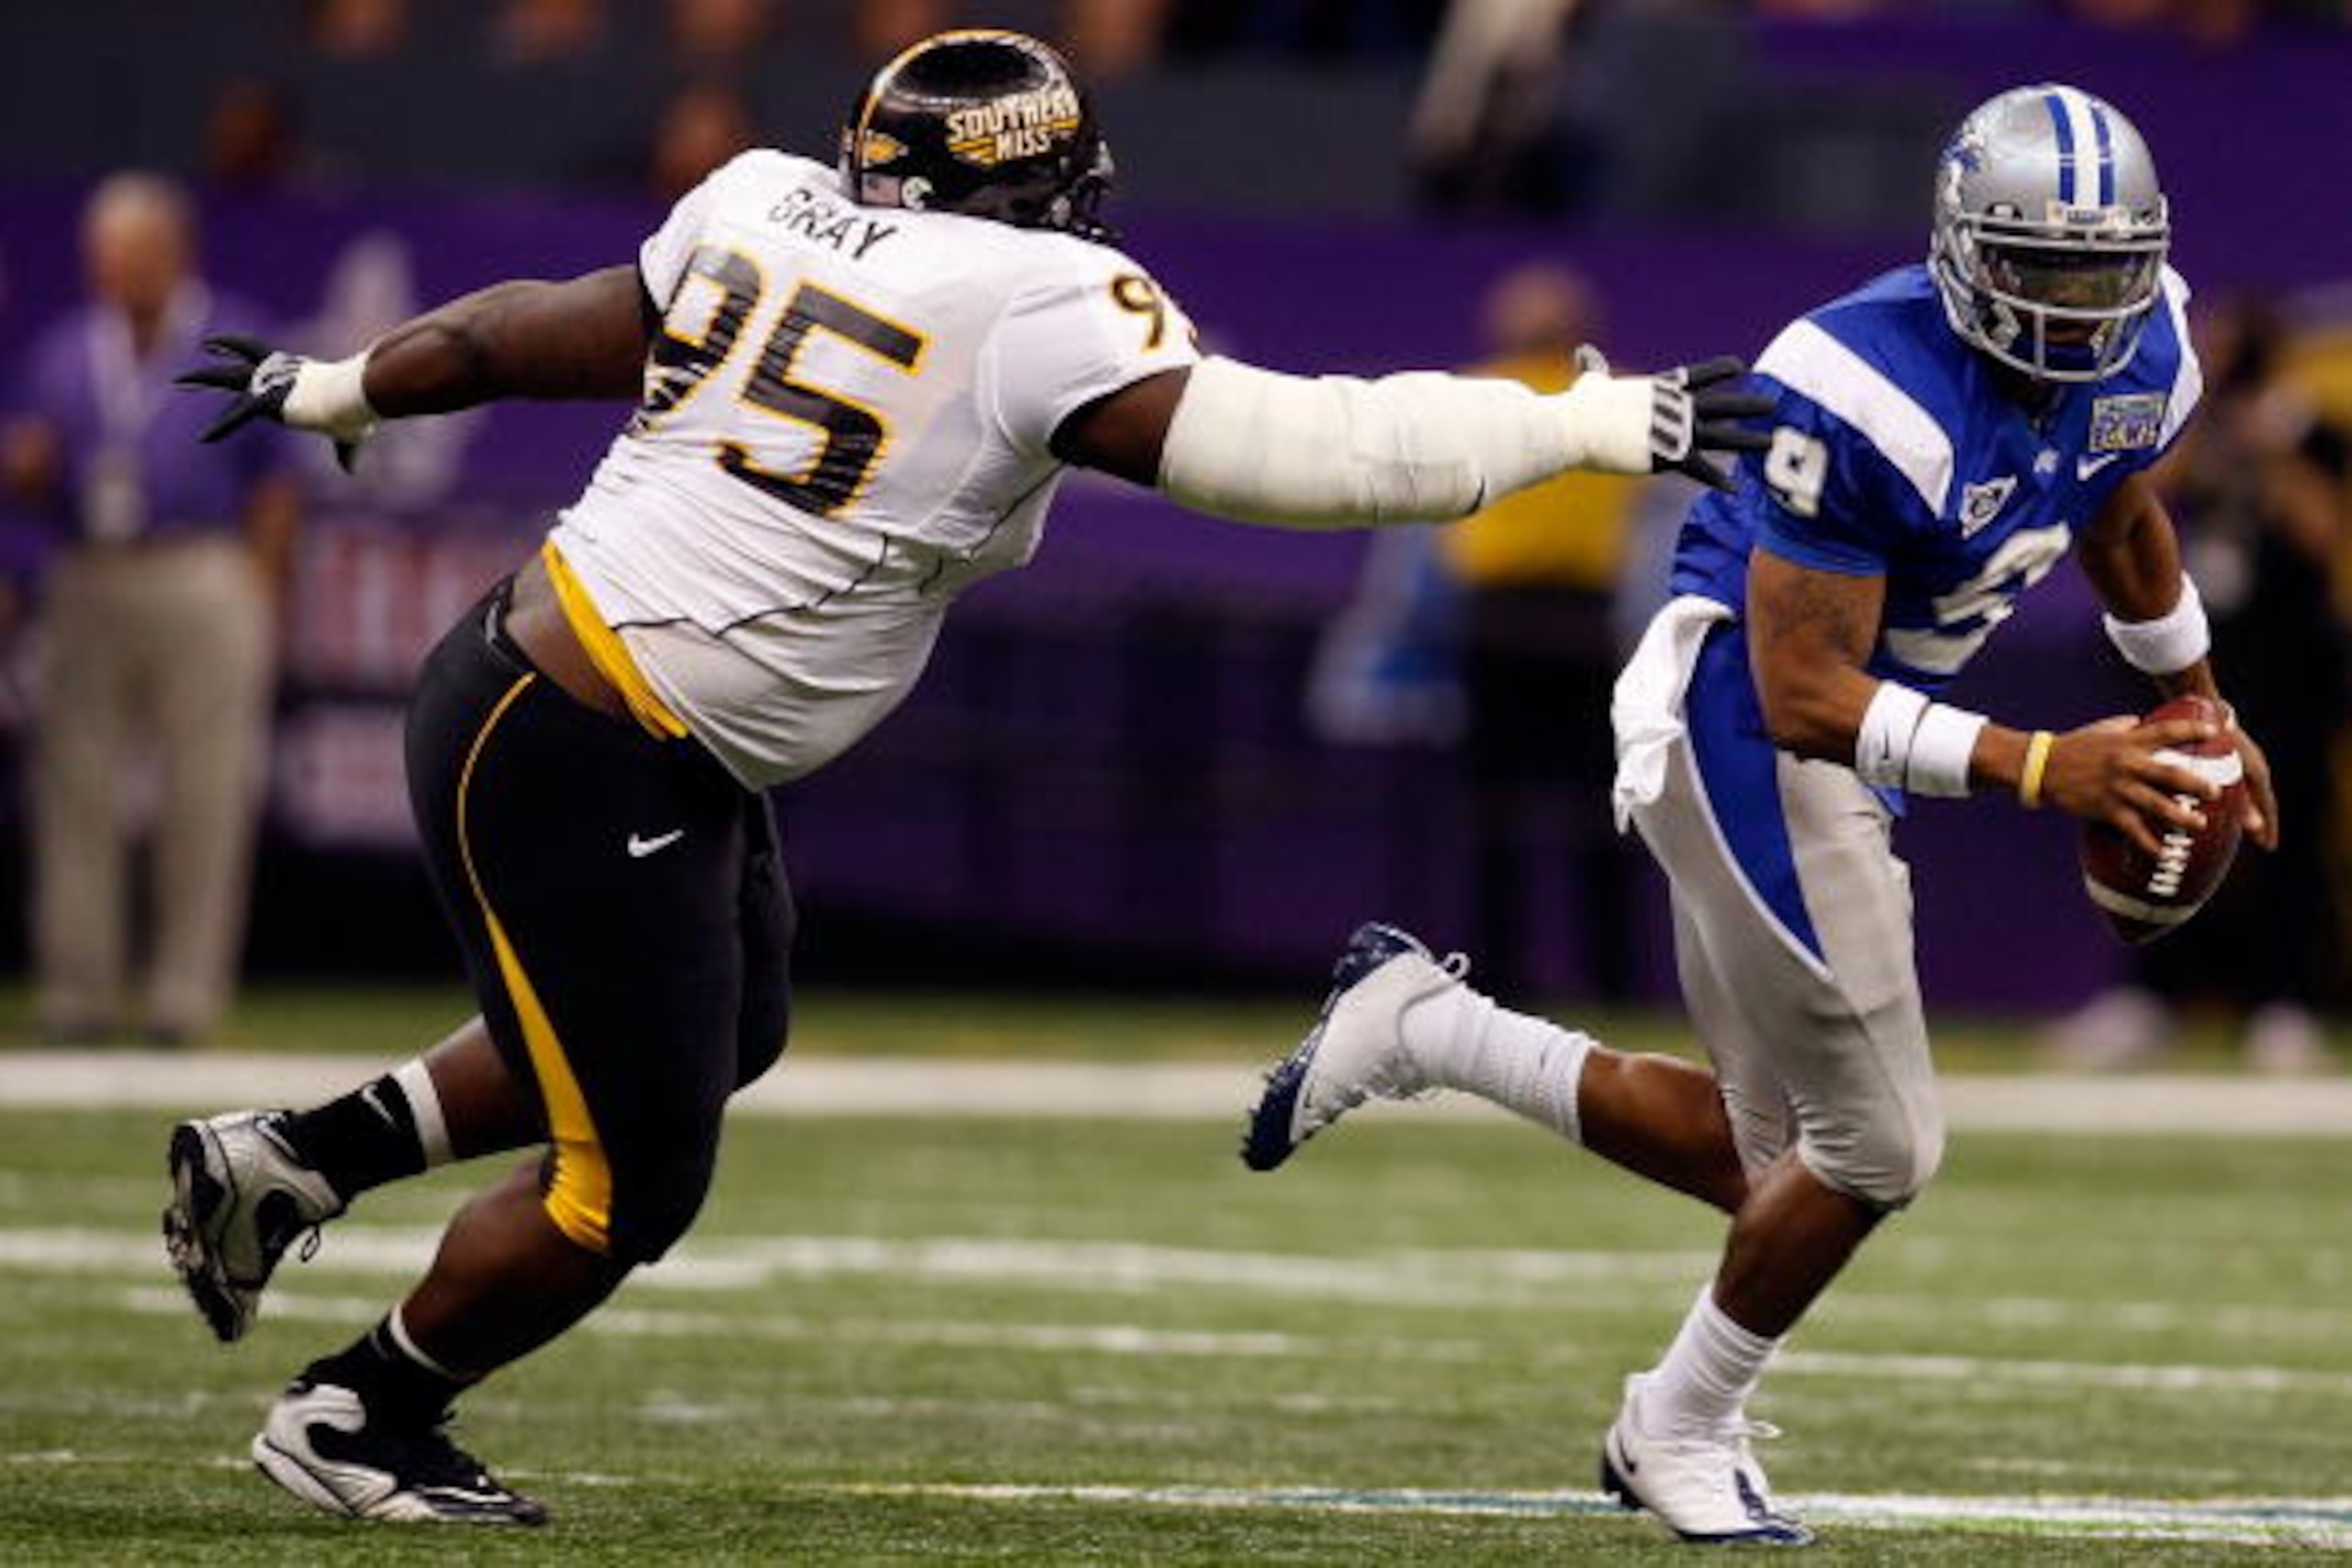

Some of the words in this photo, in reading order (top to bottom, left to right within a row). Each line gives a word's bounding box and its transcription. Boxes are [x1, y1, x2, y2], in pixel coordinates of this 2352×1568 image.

[996, 126, 1052, 161] MISS
[768, 187, 898, 260] GRAY
[1764, 425, 1826, 516] 9
